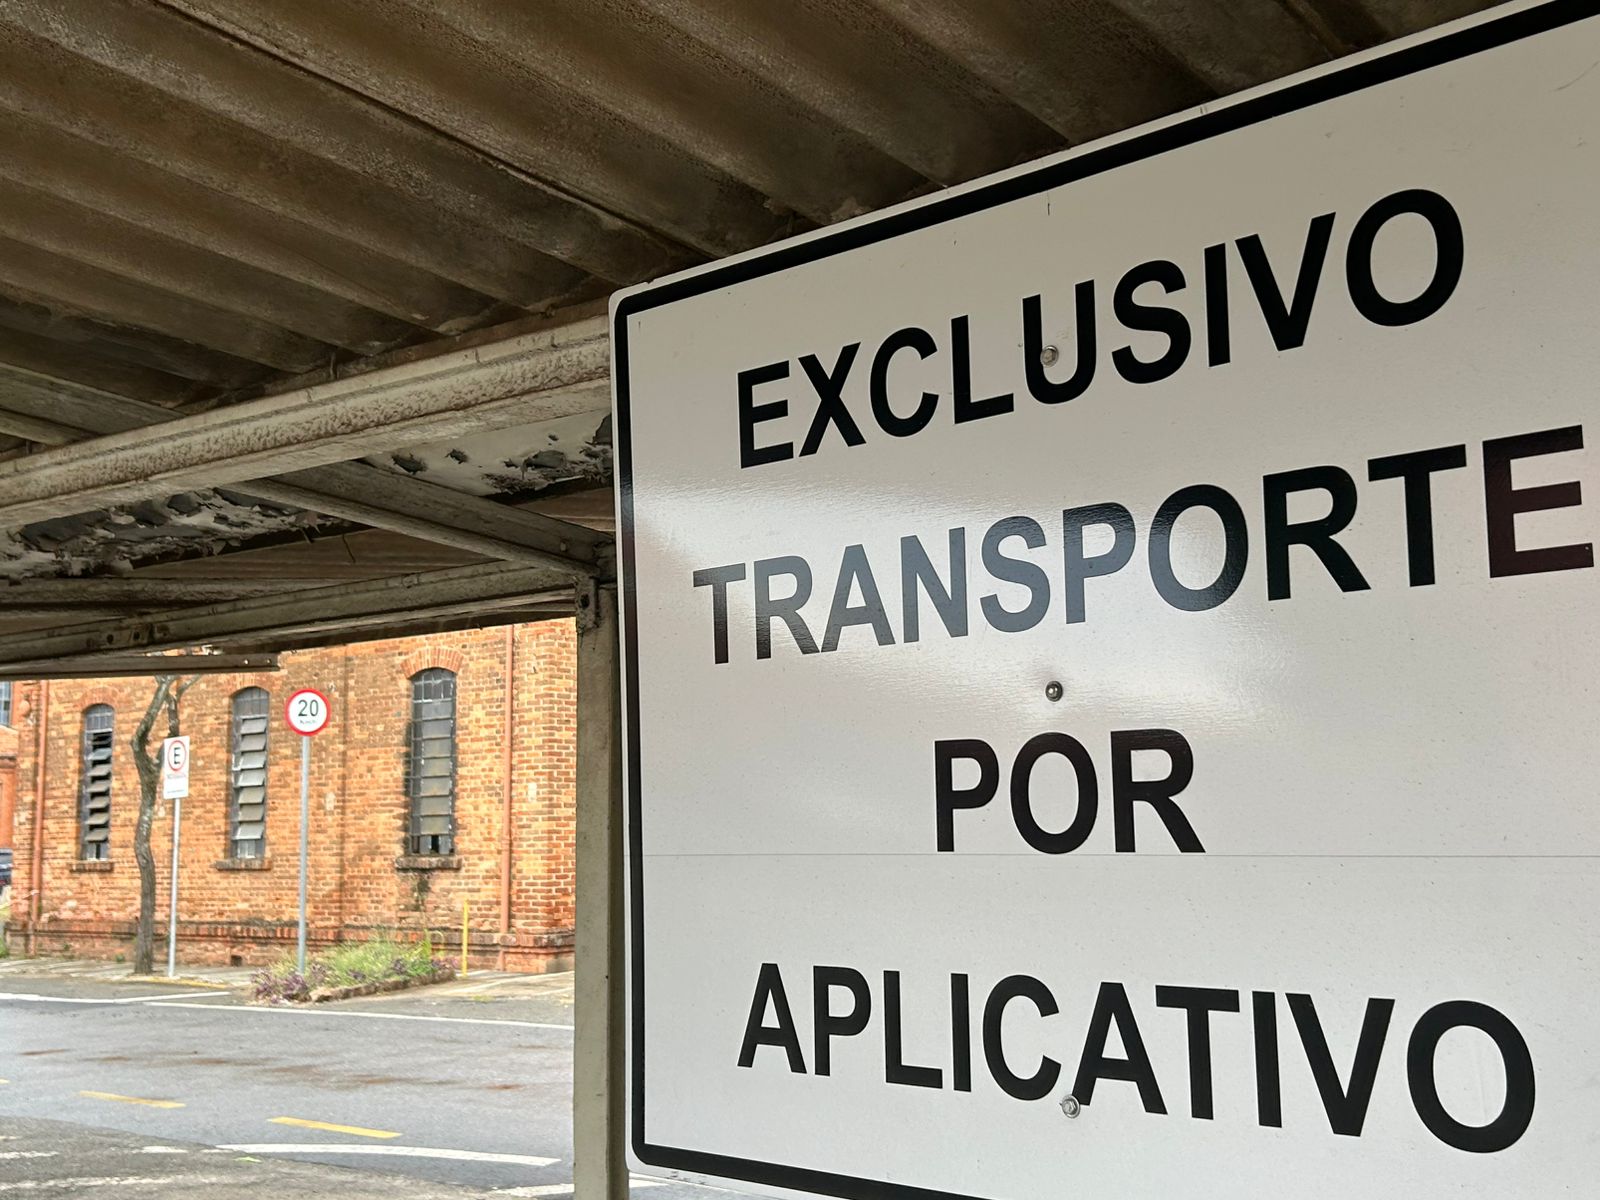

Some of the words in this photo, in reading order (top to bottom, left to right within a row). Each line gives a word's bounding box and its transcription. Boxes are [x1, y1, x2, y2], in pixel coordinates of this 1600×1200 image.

[737, 188, 1465, 470] EXCLUSIVO
[693, 424, 1595, 665] TRANSPORTE
[173, 746, 181, 765] E
[298, 699, 319, 717] 20
[934, 728, 1207, 856] POR
[736, 962, 1536, 1154] APLICATIVO
